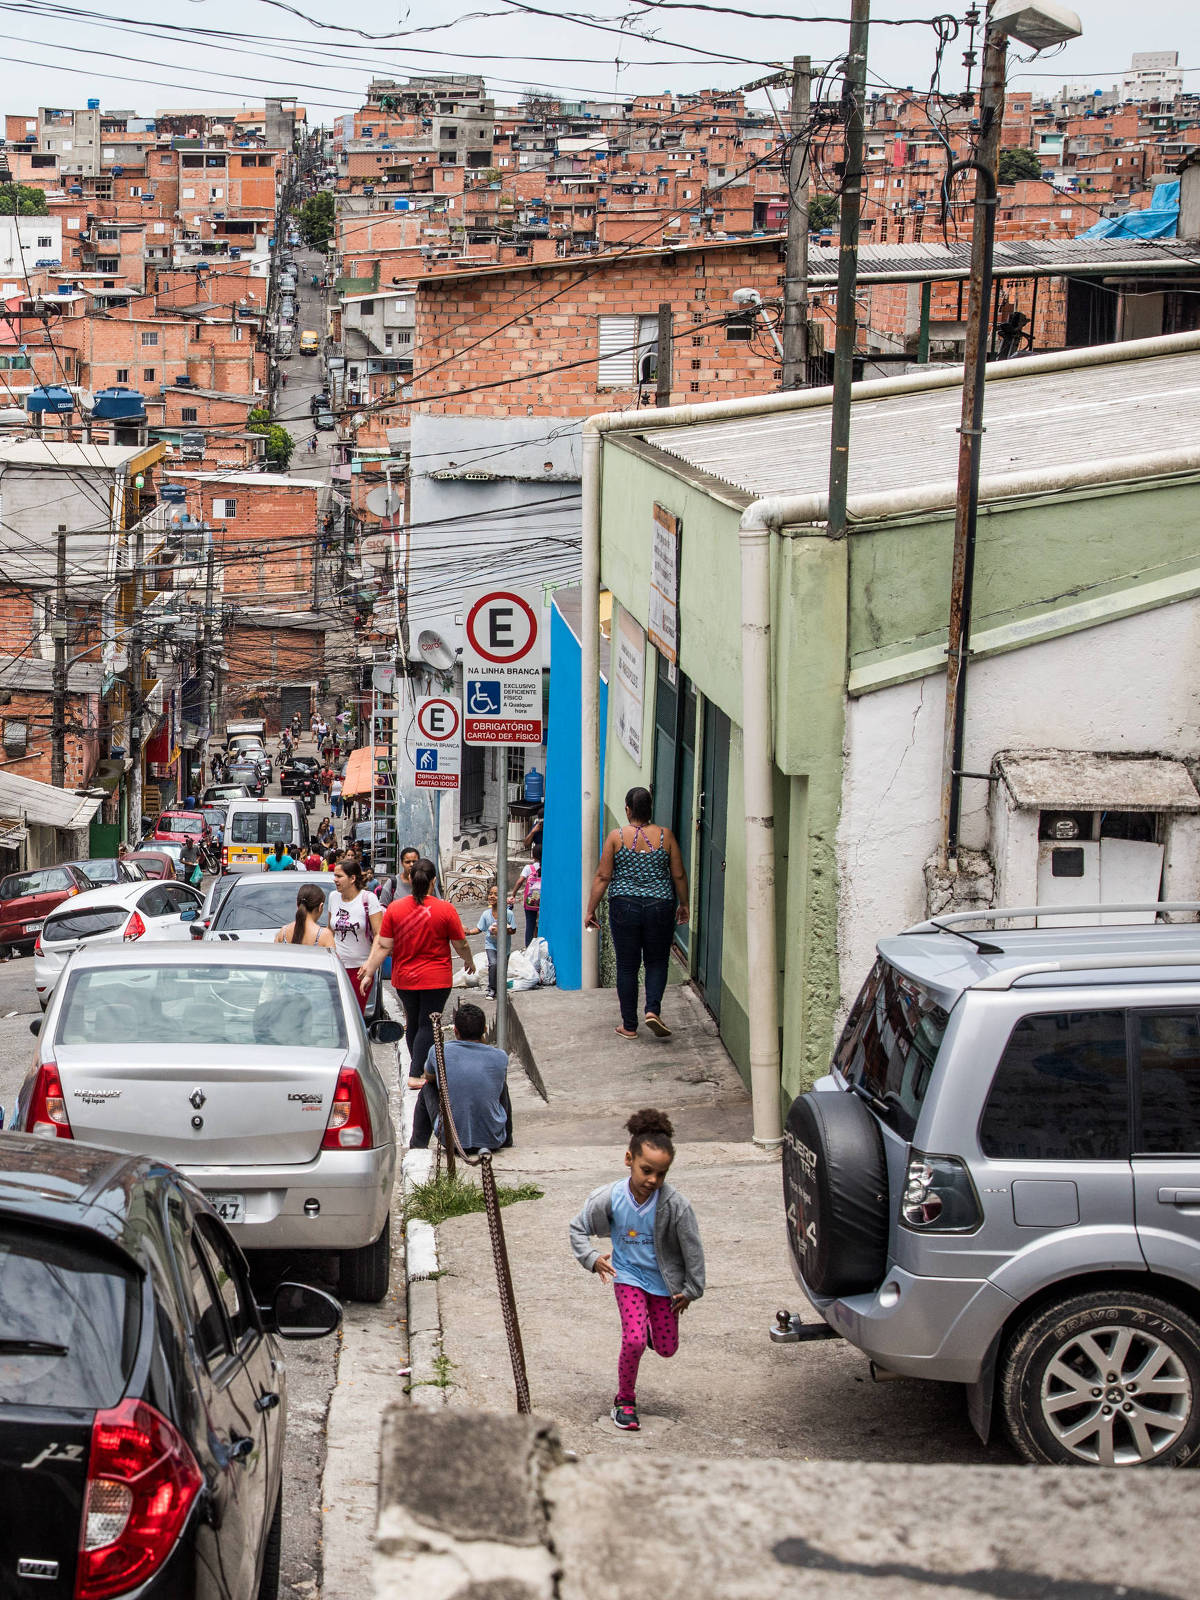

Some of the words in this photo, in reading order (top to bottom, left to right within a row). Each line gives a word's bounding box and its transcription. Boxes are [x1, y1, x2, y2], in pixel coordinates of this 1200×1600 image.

[489, 608, 514, 648] E
[422, 640, 441, 651] Claro
[430, 708, 445, 732] E
[472, 721, 534, 731] OBRIGATÓRIO
[467, 731, 497, 739] CARTÃO
[498, 732, 513, 740] DEF.
[515, 731, 540, 741] FÍSICO
[73, 1089, 122, 1098] RENAULT
[287, 1093, 322, 1101] LOGAN
[1054, 1309, 1119, 1340] BRAVO
[1131, 1311, 1174, 1334] A/T
